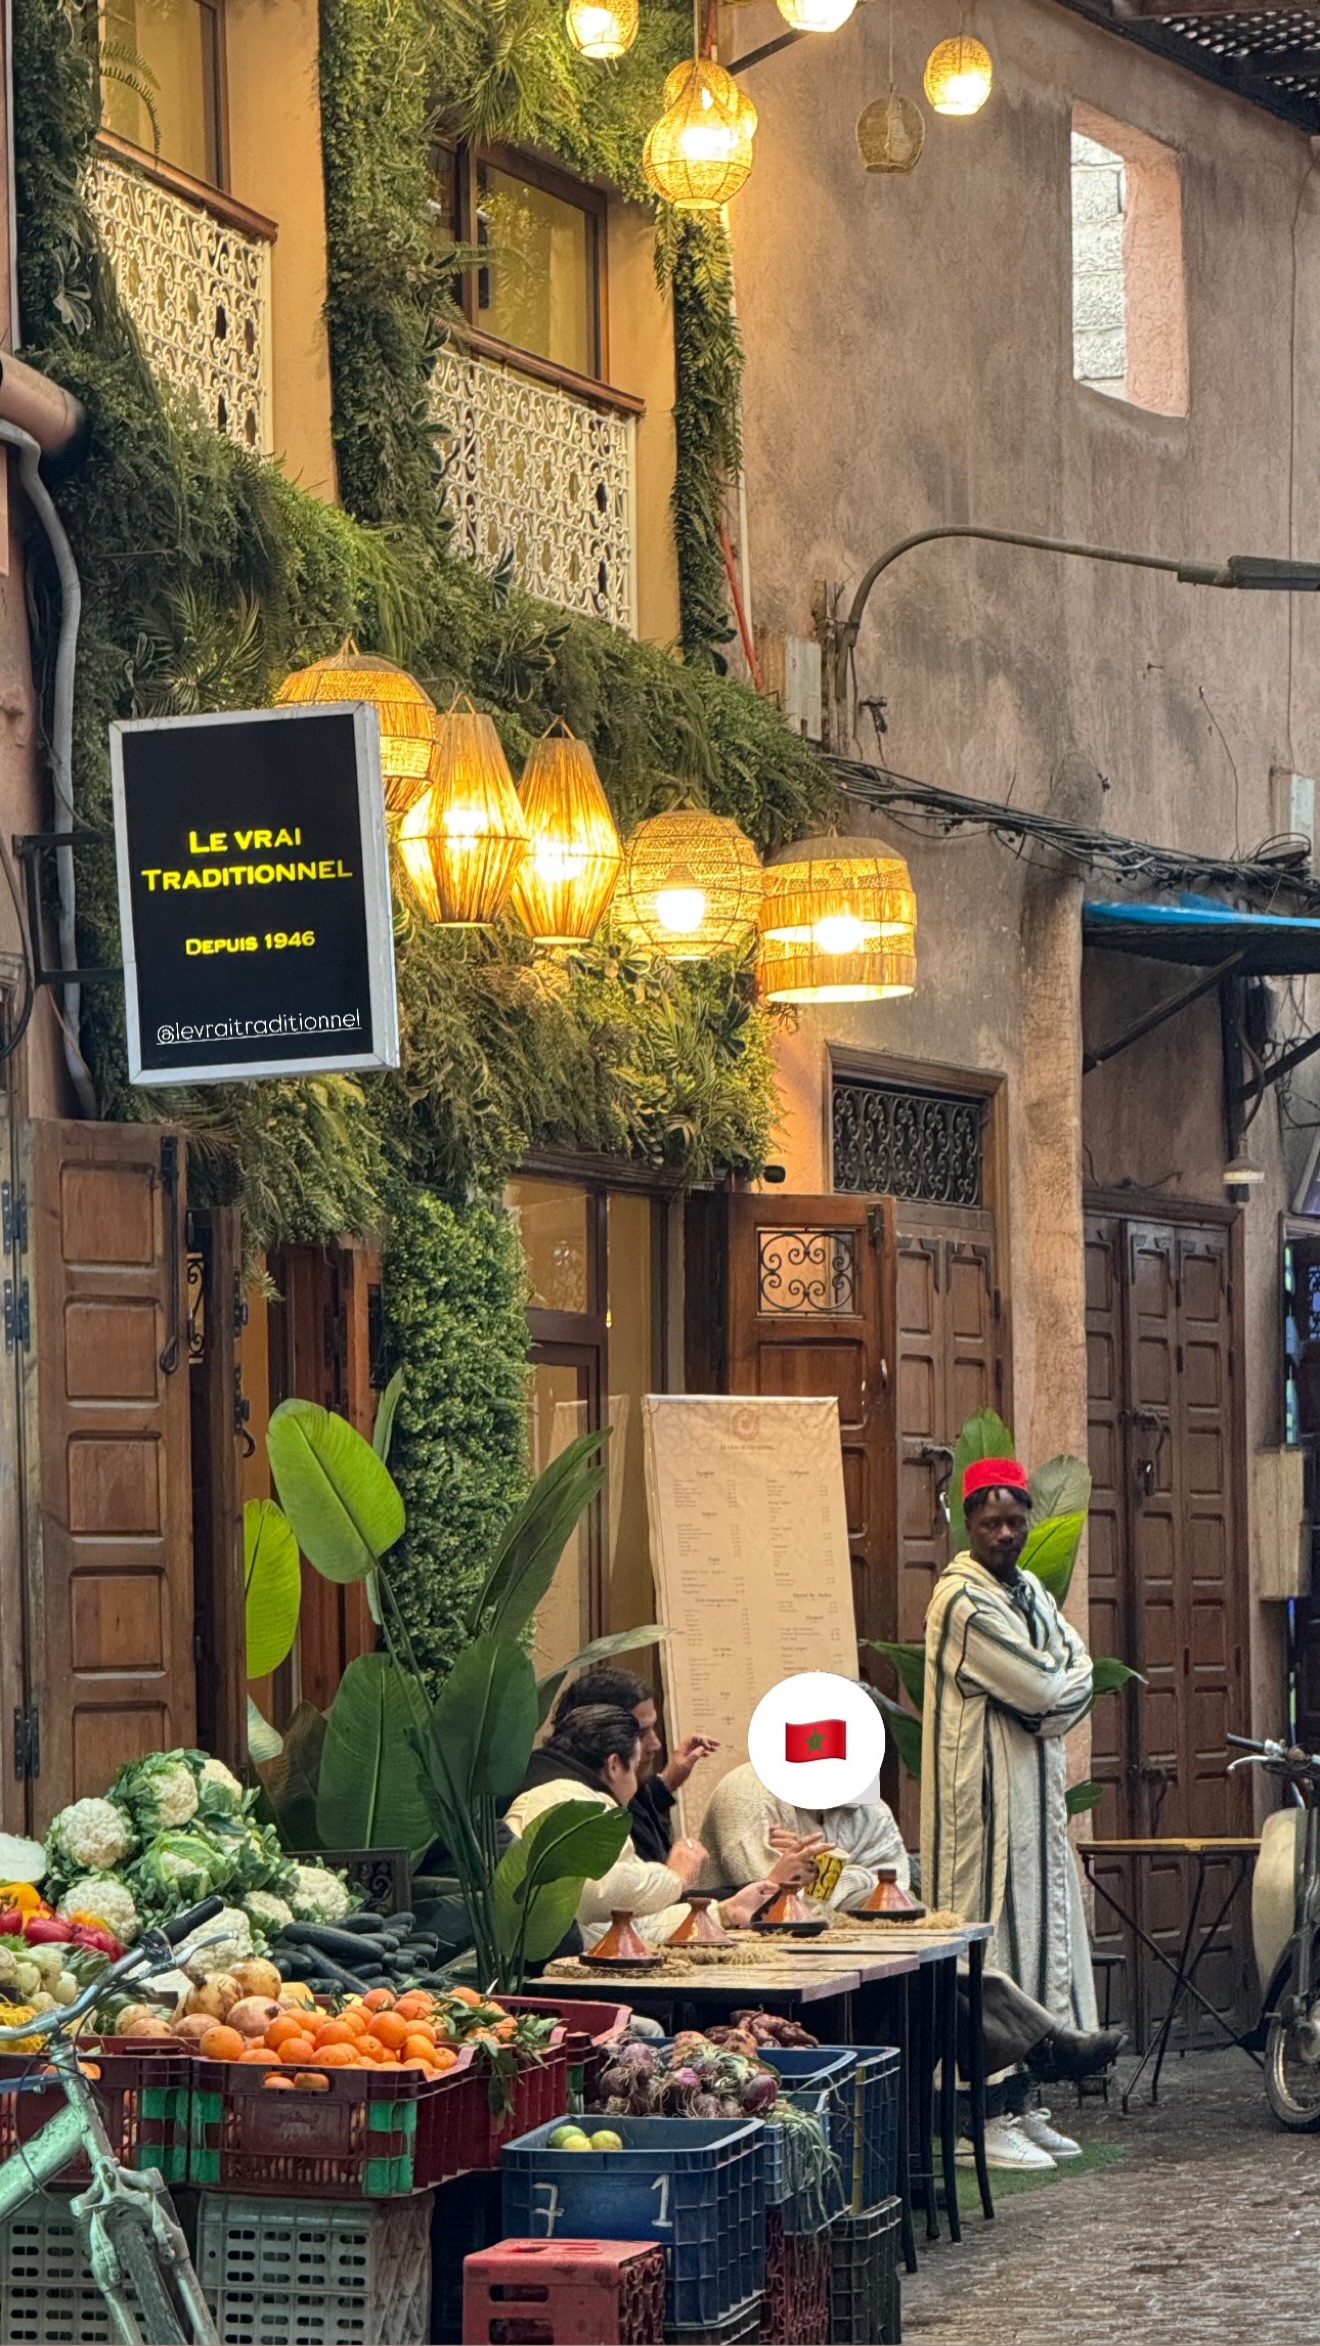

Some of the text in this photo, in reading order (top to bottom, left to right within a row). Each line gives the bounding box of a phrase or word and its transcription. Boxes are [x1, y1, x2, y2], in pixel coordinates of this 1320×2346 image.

[188, 827, 301, 854] LE VRAI
[141, 860, 352, 891] TRADITIONNEL
[186, 931, 315, 955] DEPUIS 1946
[157, 1008, 361, 1045] @levraitraditionnel
[533, 2174, 673, 2237] 7 1
